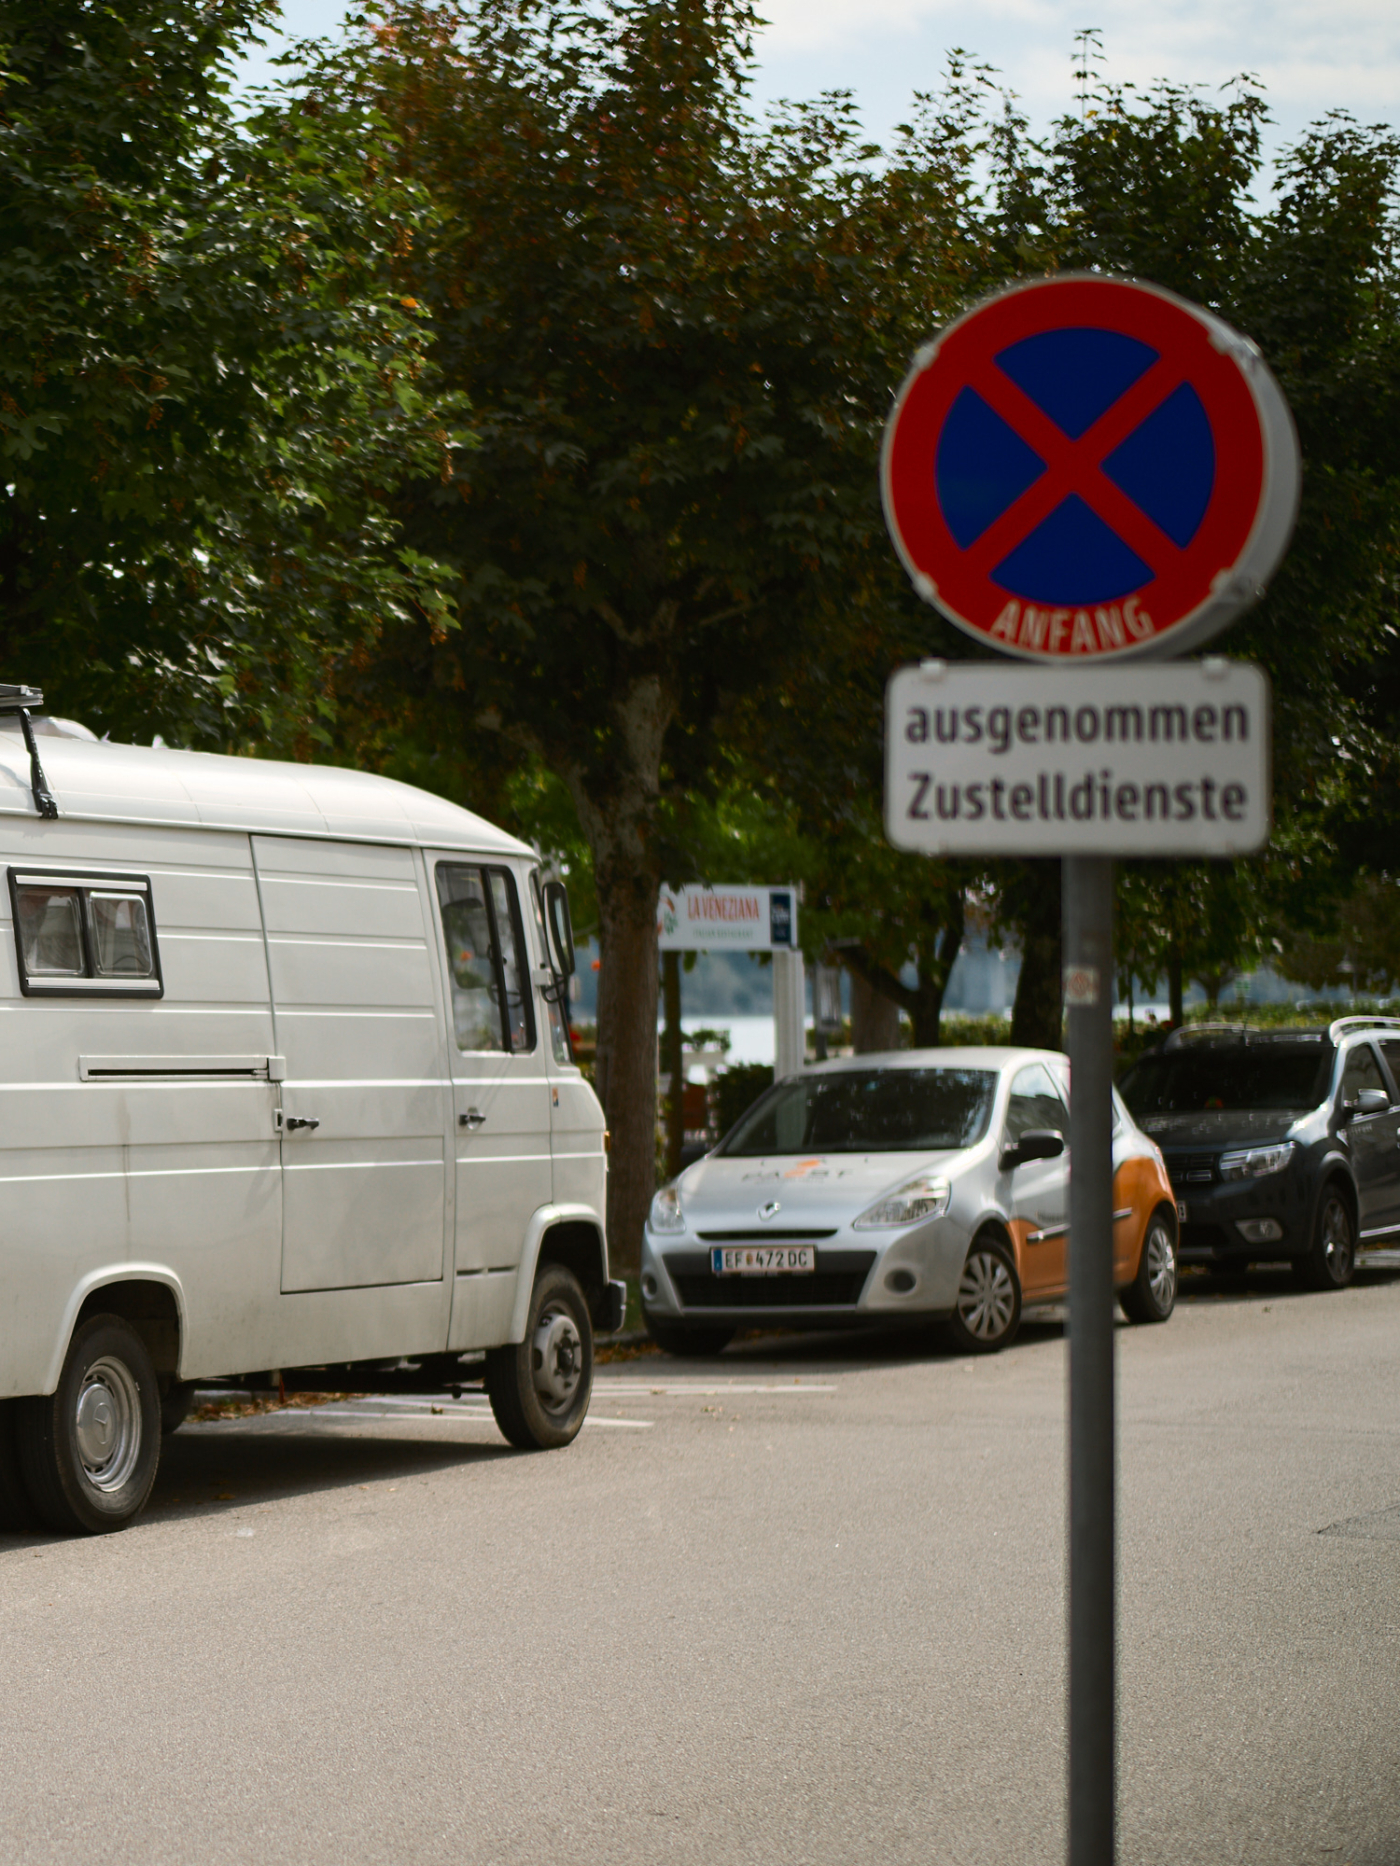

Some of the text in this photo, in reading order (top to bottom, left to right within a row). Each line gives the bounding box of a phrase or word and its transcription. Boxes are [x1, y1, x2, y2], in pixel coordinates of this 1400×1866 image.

[988, 595, 1156, 653] ANFANG
[905, 702, 1250, 755] ausgenommen
[907, 768, 1248, 821] Zustelldienste
[725, 1251, 743, 1269] EF
